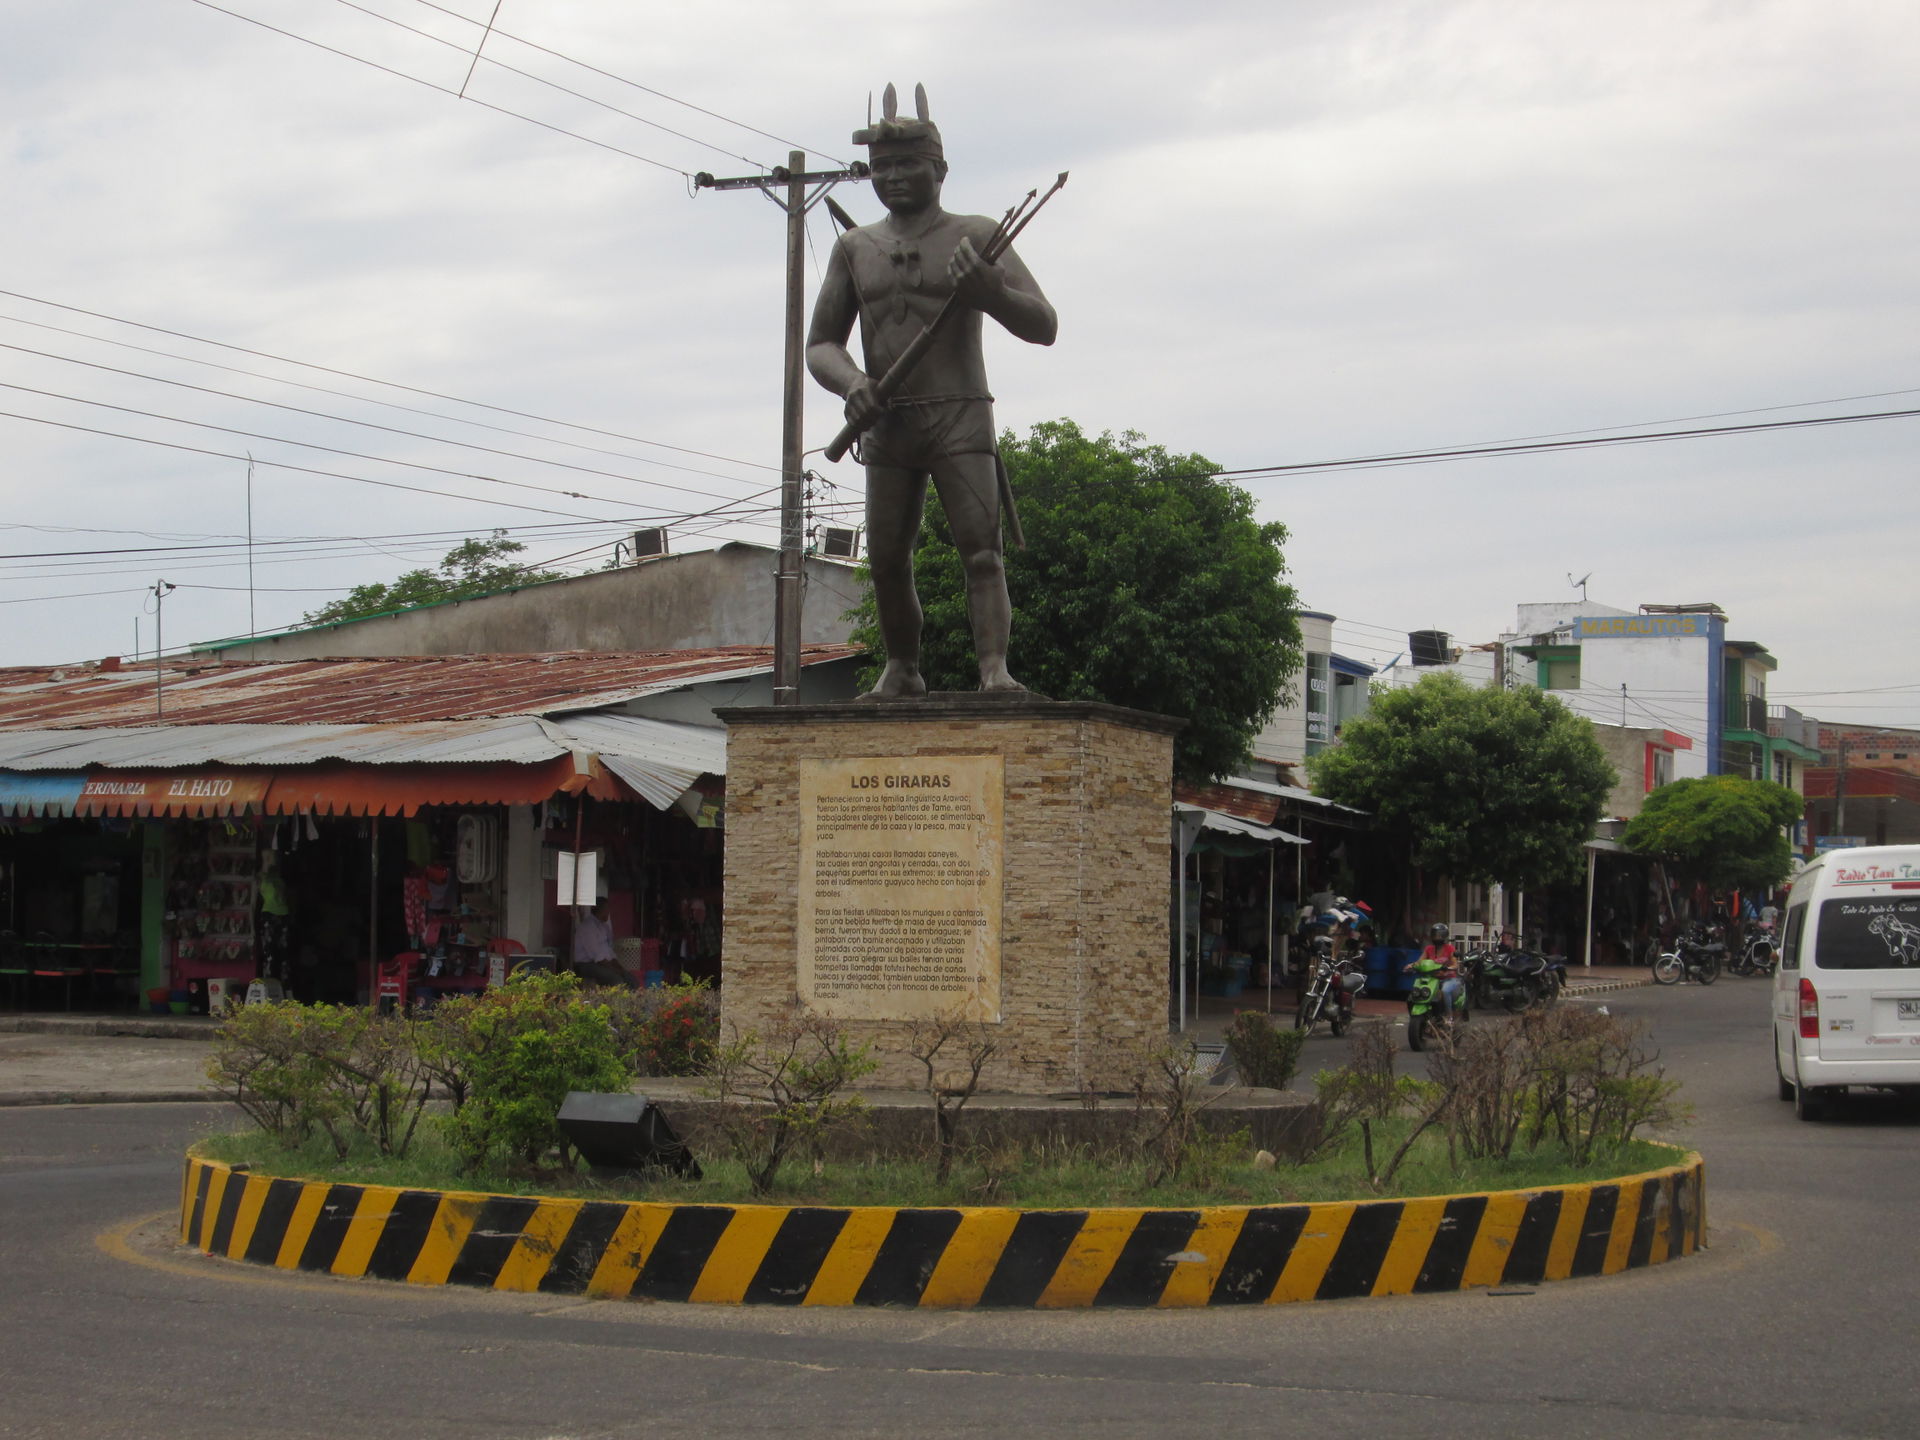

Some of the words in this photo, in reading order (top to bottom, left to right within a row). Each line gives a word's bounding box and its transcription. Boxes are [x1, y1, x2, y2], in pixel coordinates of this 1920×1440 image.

[1581, 618, 1696, 635] MARAUTOS
[851, 776, 880, 788] LOS
[885, 775, 950, 788] GIRARAS
[80, 782, 146, 794] ERINARIA
[168, 780, 187, 796] EL
[190, 780, 233, 796] HATO
[816, 814, 860, 823] trabajadores
[862, 814, 887, 822] alegres
[816, 823, 868, 832] principalmente
[869, 860, 900, 869] angostas
[852, 869, 877, 878] puertas
[1836, 870, 1866, 881] Radio
[1867, 866, 1895, 879] Taxi
[956, 878, 975, 887] hojas
[815, 936, 846, 945] pintaban
[814, 945, 850, 954] guirnaldas
[867, 946, 892, 954] plumas
[861, 955, 886, 964] alegrar
[814, 964, 849, 972] trompetas
